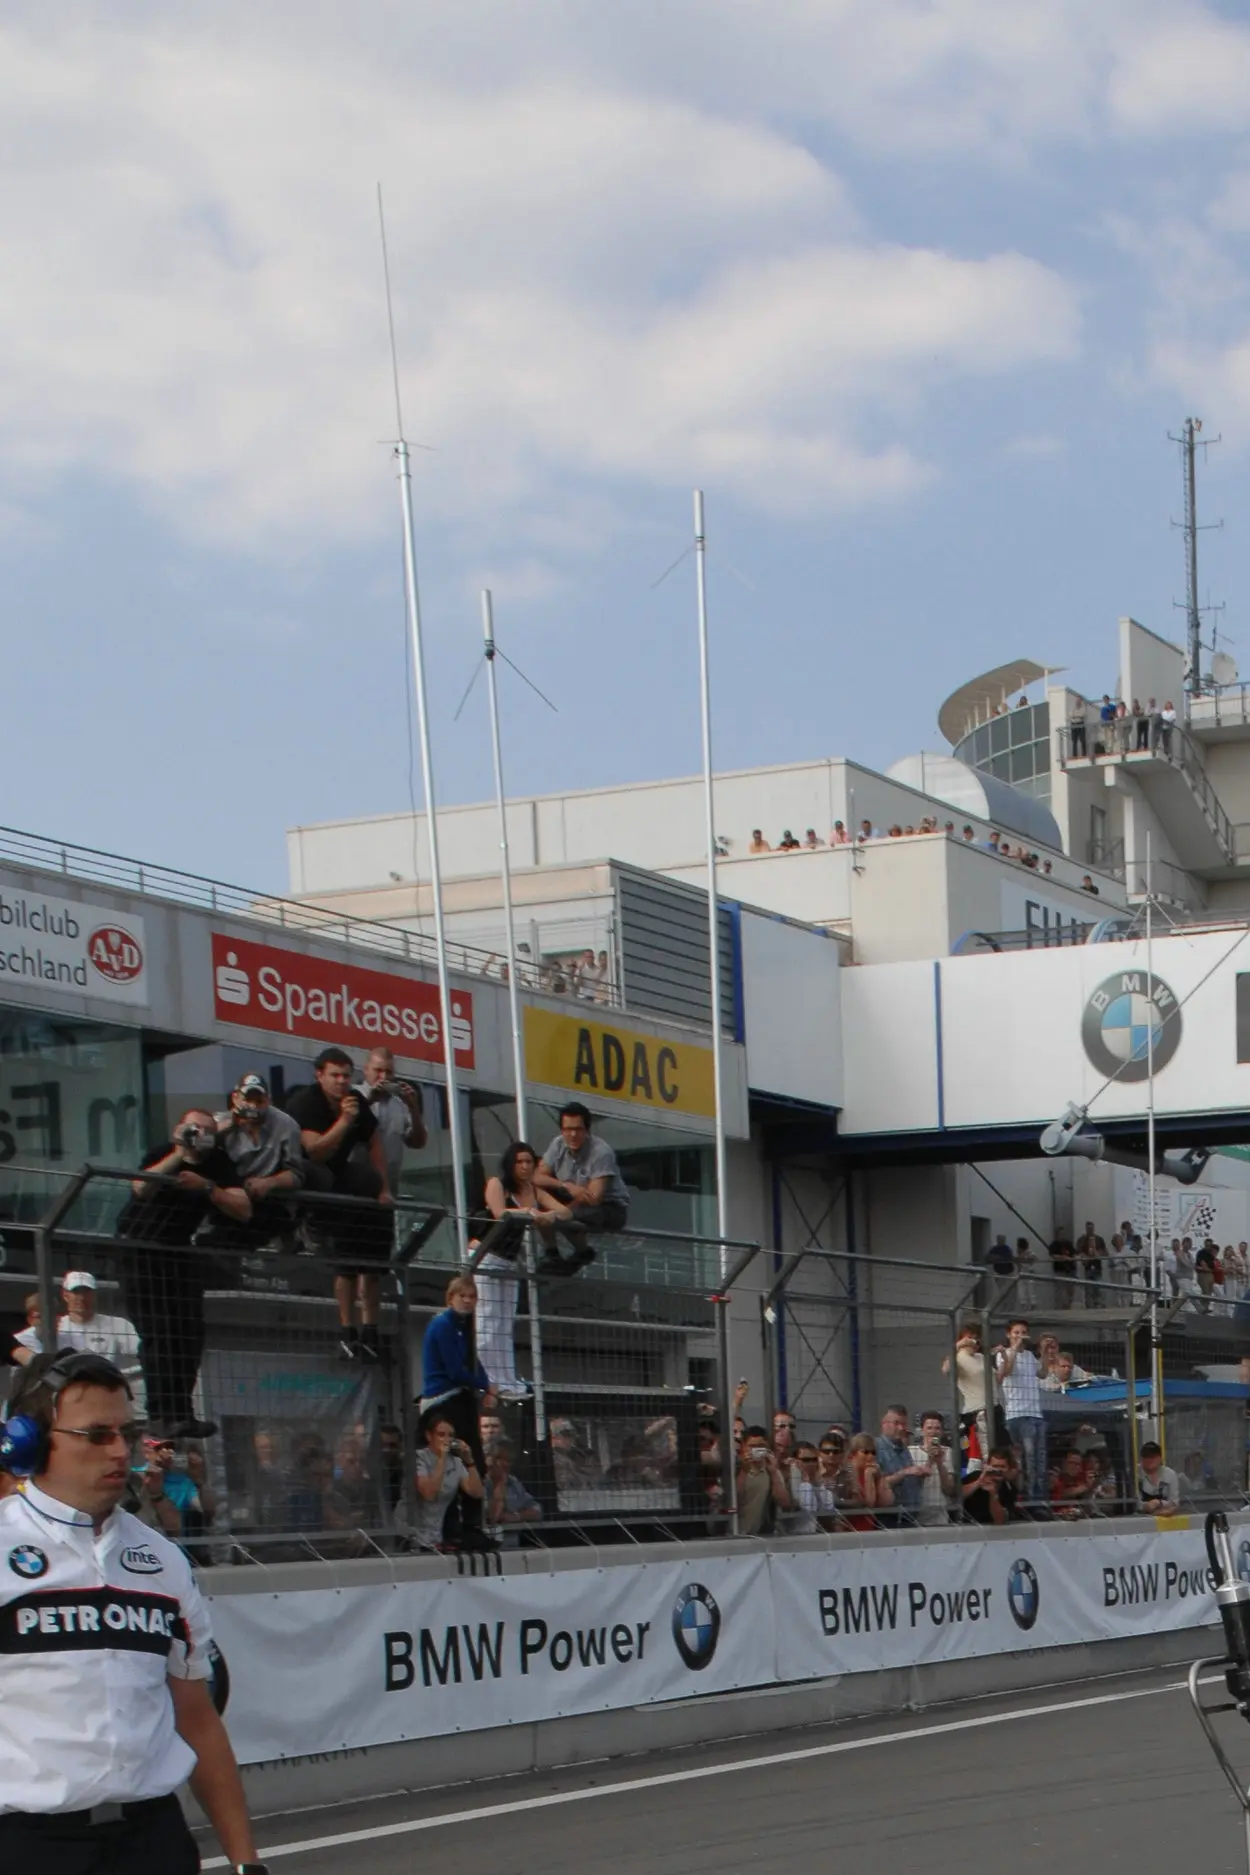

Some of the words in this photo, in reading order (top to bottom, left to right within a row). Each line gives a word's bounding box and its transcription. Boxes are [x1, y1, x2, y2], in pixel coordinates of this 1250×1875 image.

[257, 966, 439, 1046] Sparkasse
[1090, 973, 1174, 1012] BMW
[574, 1027, 679, 1104] ADAC
[818, 1584, 899, 1637] BMW
[910, 1582, 992, 1629] Power
[1103, 1562, 1159, 1607] BMW
[1165, 1561, 1218, 1600] Powe
[384, 1621, 506, 1692] BMW
[520, 1618, 651, 1675] Power
